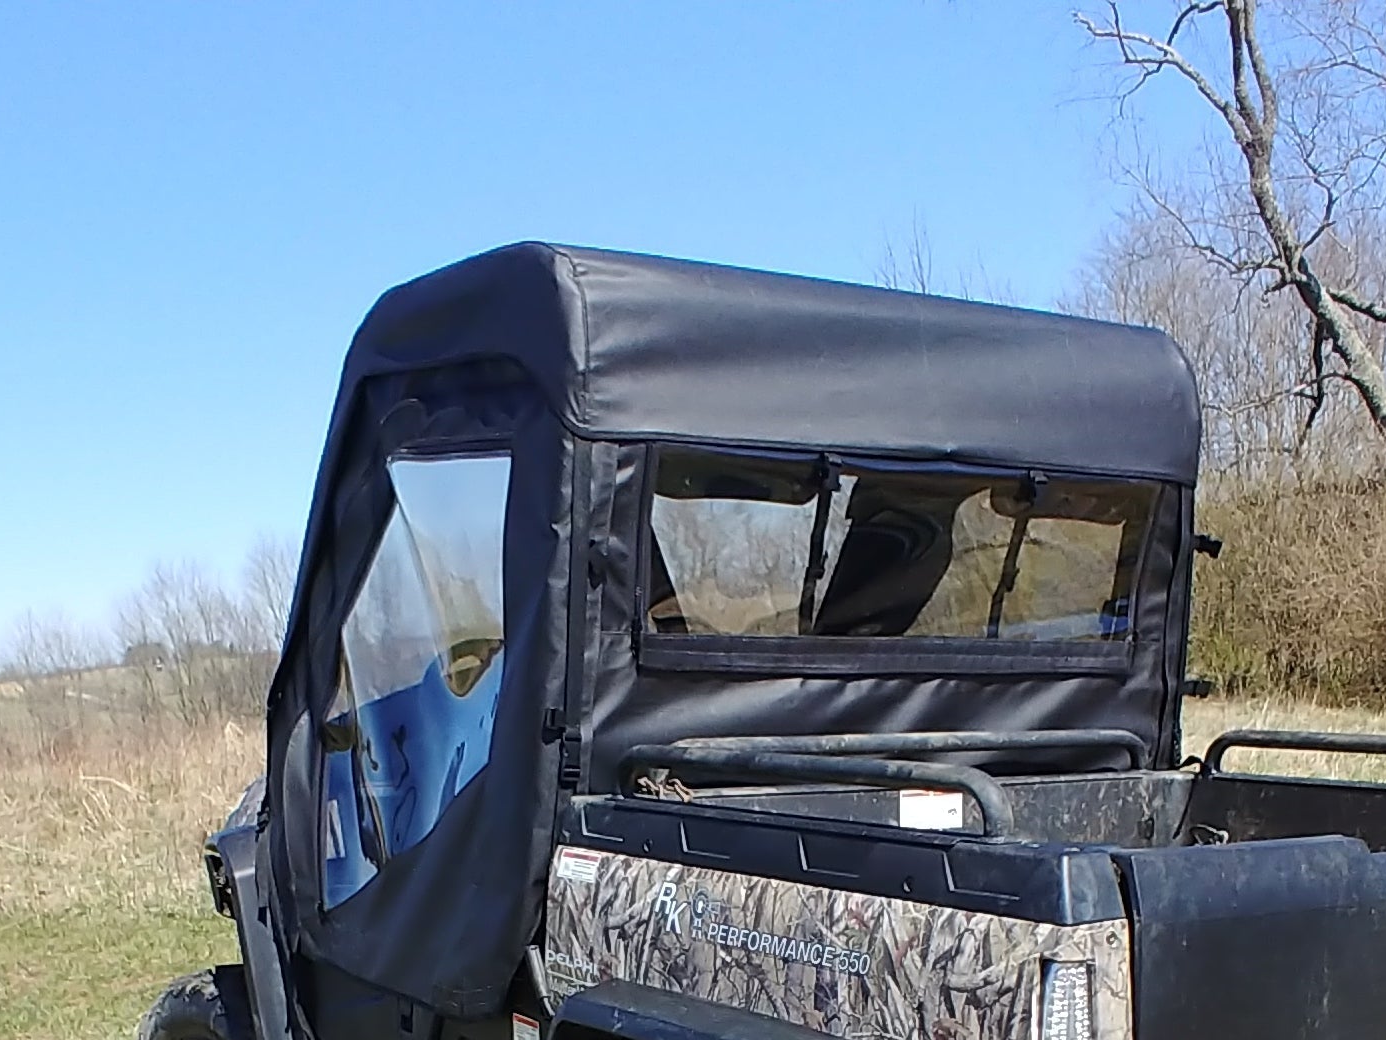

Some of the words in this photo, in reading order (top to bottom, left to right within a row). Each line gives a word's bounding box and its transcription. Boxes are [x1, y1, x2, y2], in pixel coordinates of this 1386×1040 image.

[654, 882, 688, 935] RK
[707, 922, 836, 967] PERFORMANCE
[838, 951, 871, 975] 550
[546, 949, 598, 976] DELPHI
